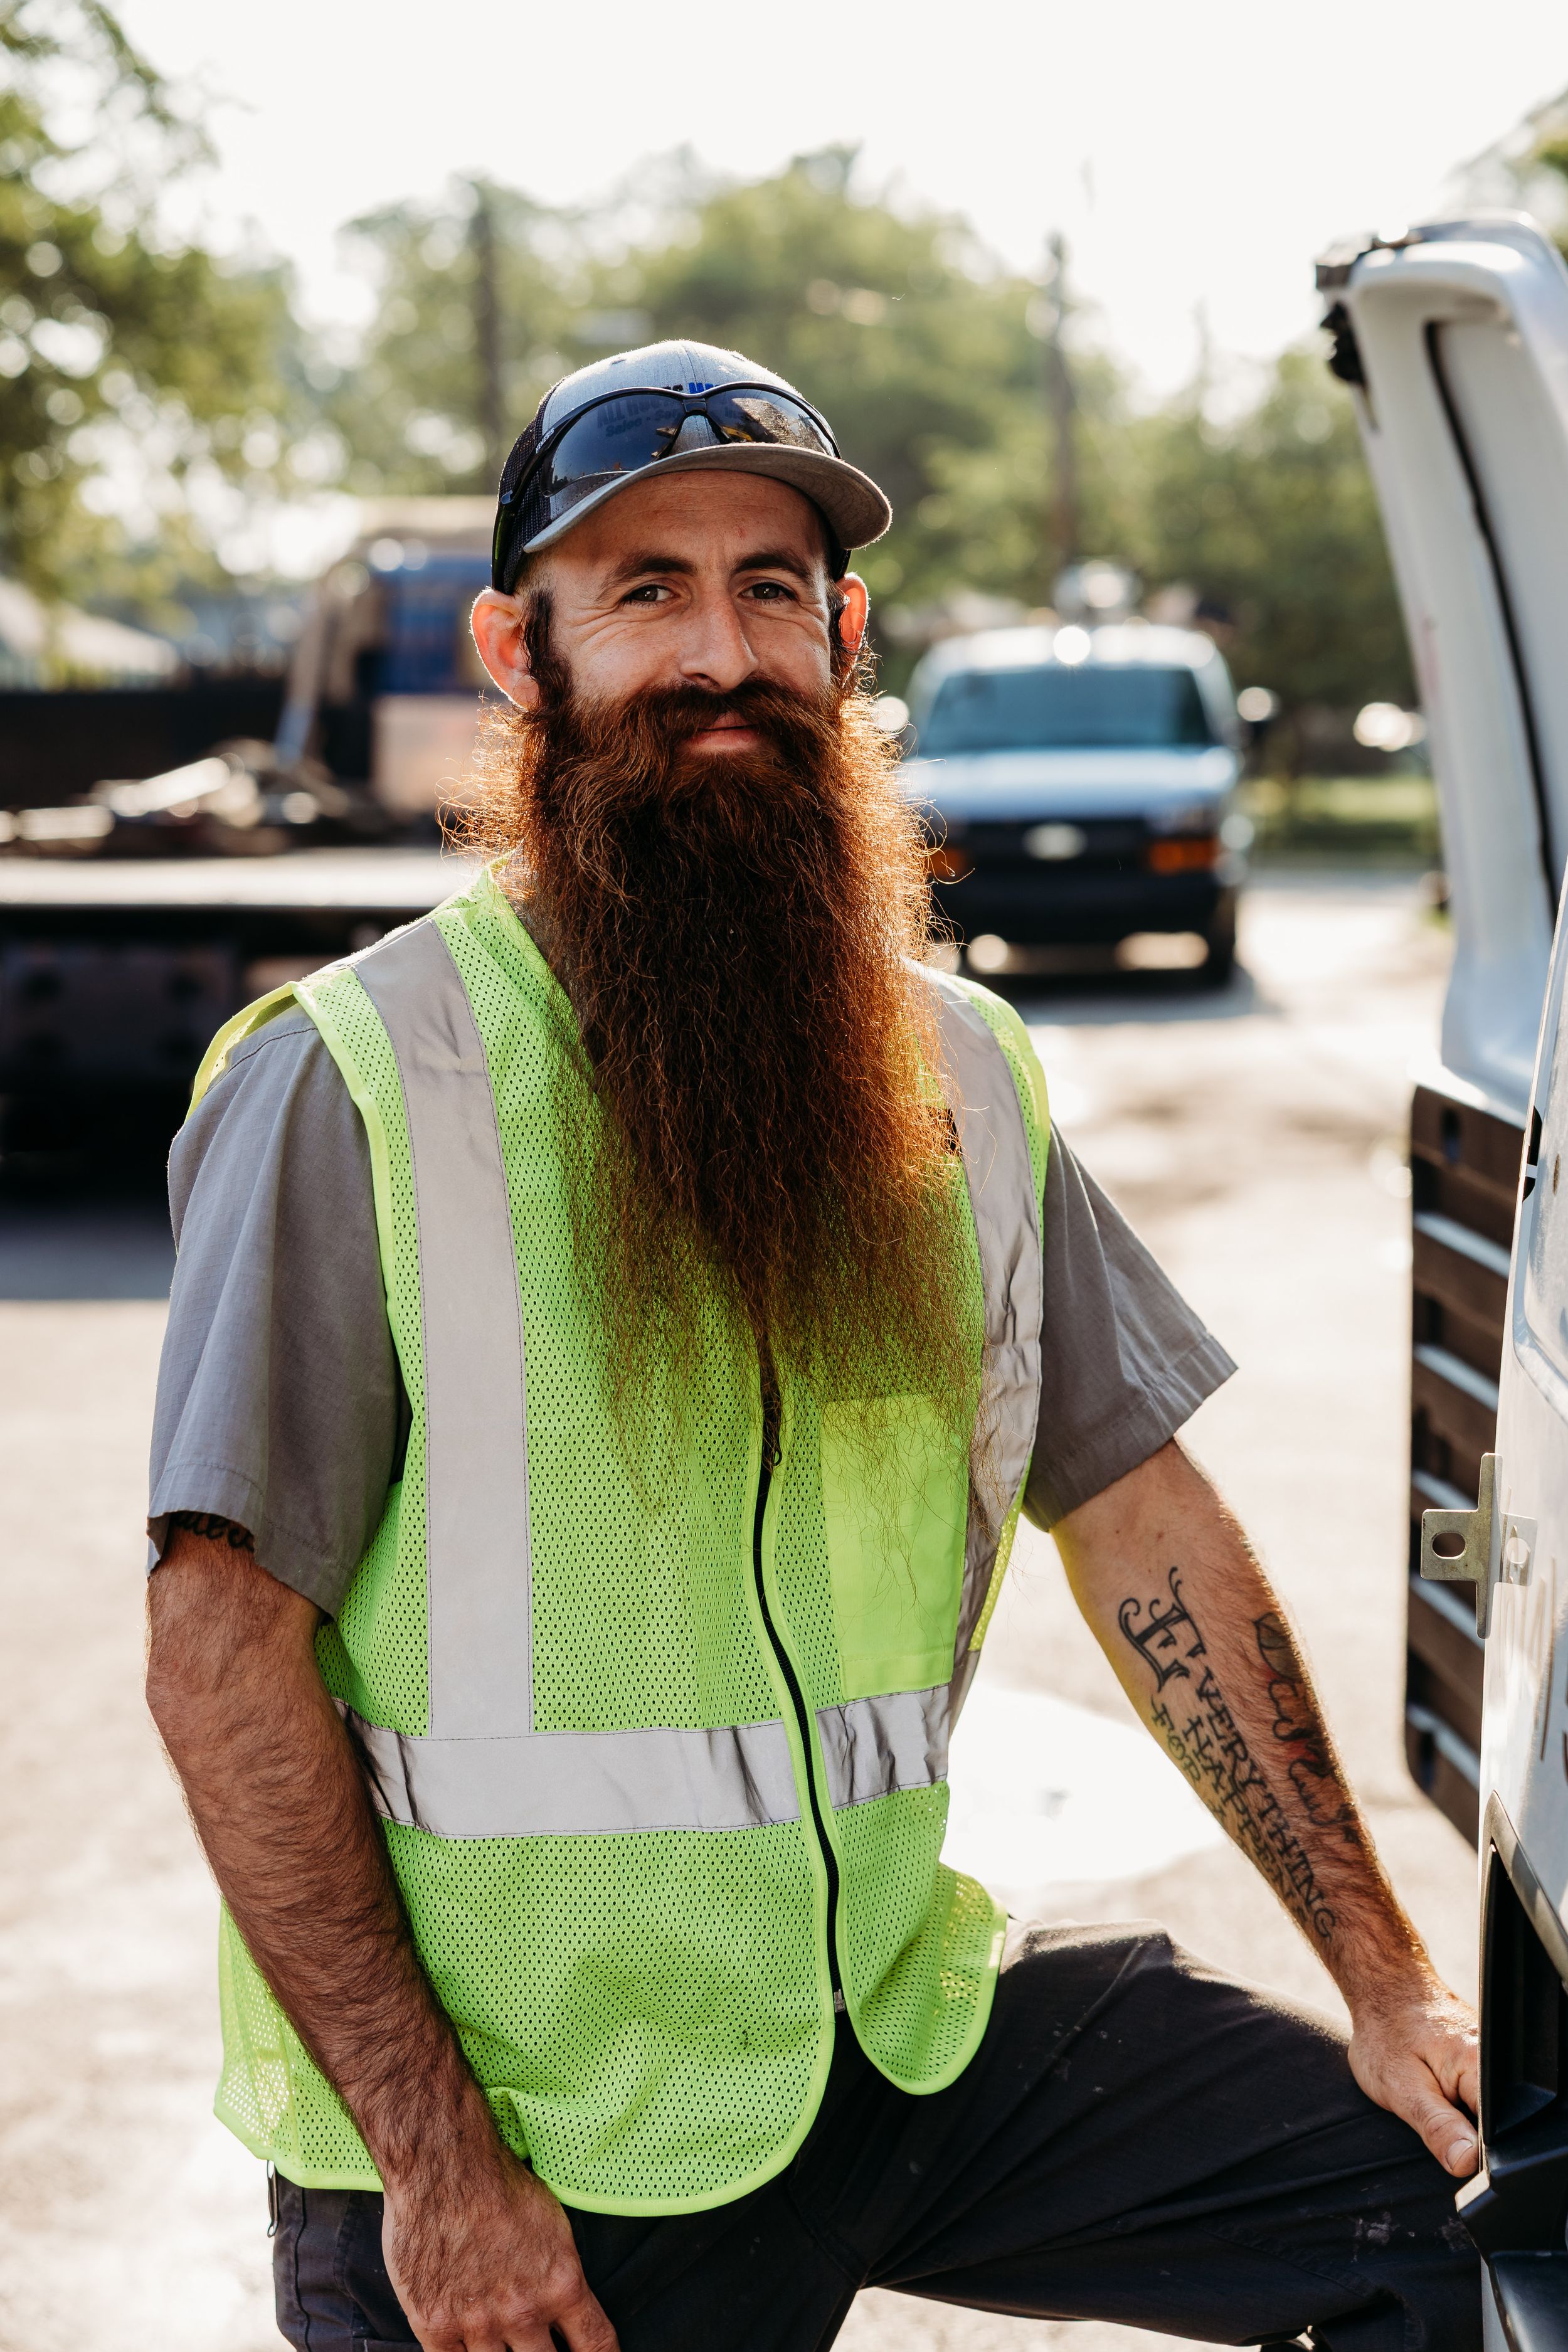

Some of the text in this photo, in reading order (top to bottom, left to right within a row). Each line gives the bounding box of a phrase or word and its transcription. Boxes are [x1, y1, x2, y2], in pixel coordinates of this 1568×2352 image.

[536, 427, 554, 453] NEMESIS
[1118, 1566, 1337, 1939] EVERYTHING
[1152, 1695, 1200, 1783] FOR
